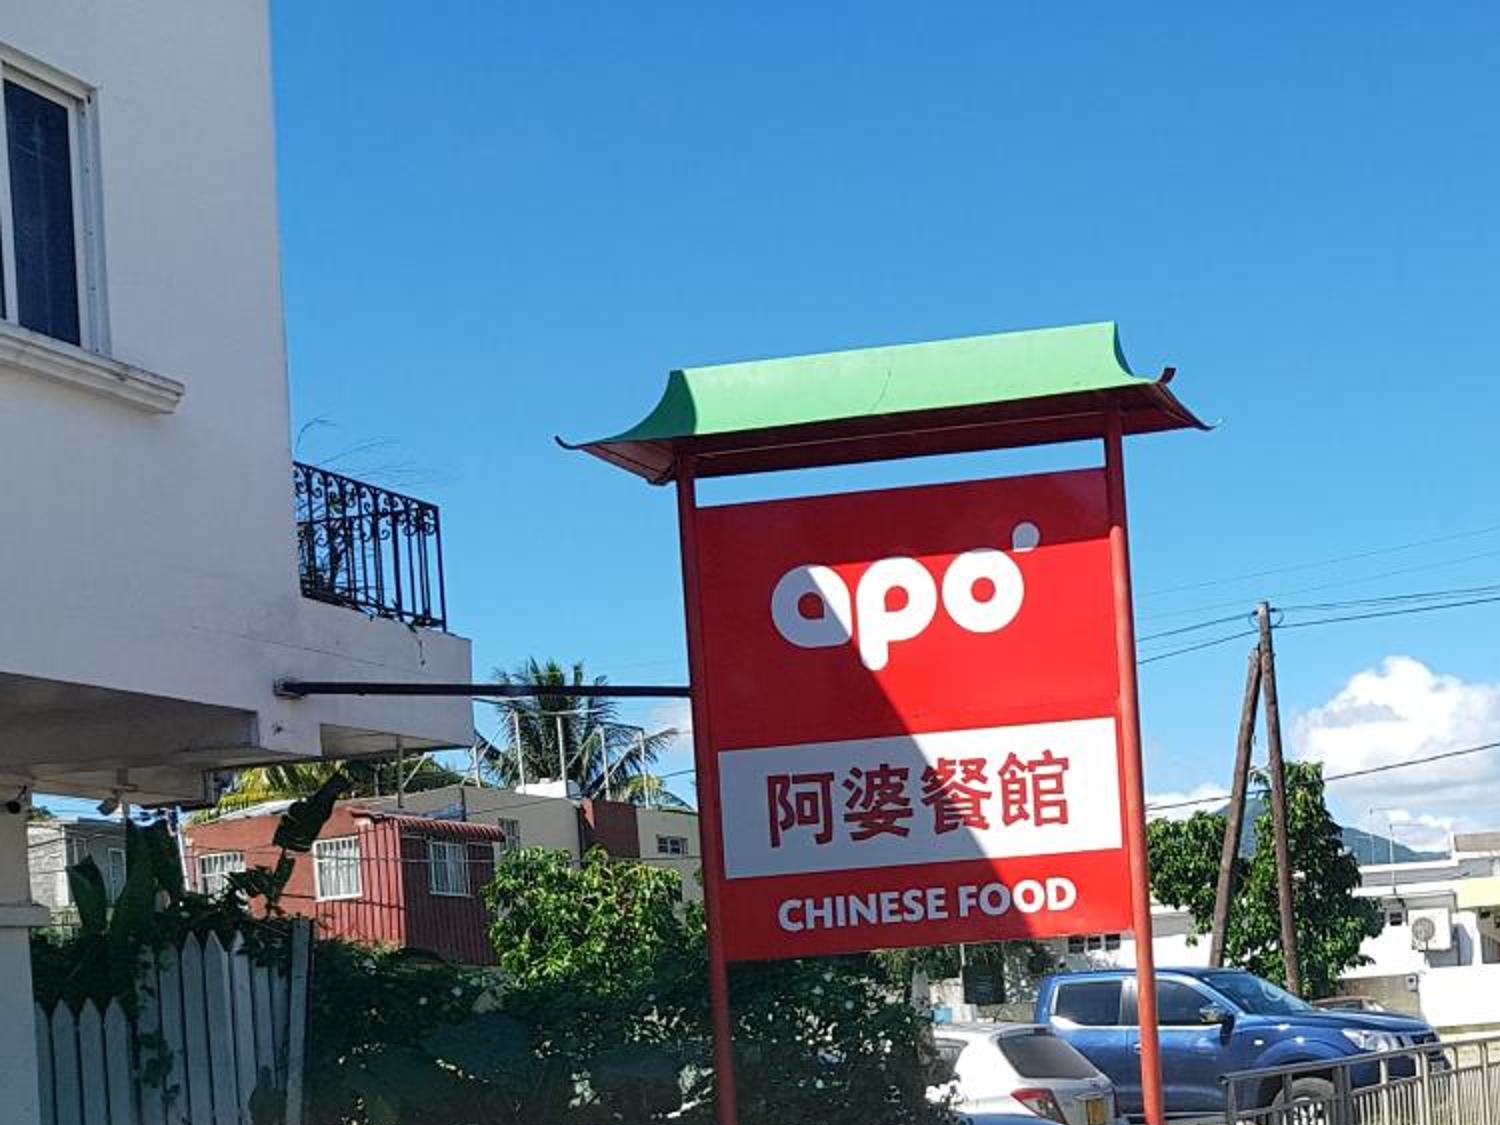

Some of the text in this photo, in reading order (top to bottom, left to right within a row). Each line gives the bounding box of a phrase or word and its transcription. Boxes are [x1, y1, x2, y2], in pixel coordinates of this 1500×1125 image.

[767, 750, 1069, 848] 阿婆餐館
[778, 877, 1077, 932] CHINESE FOOD
